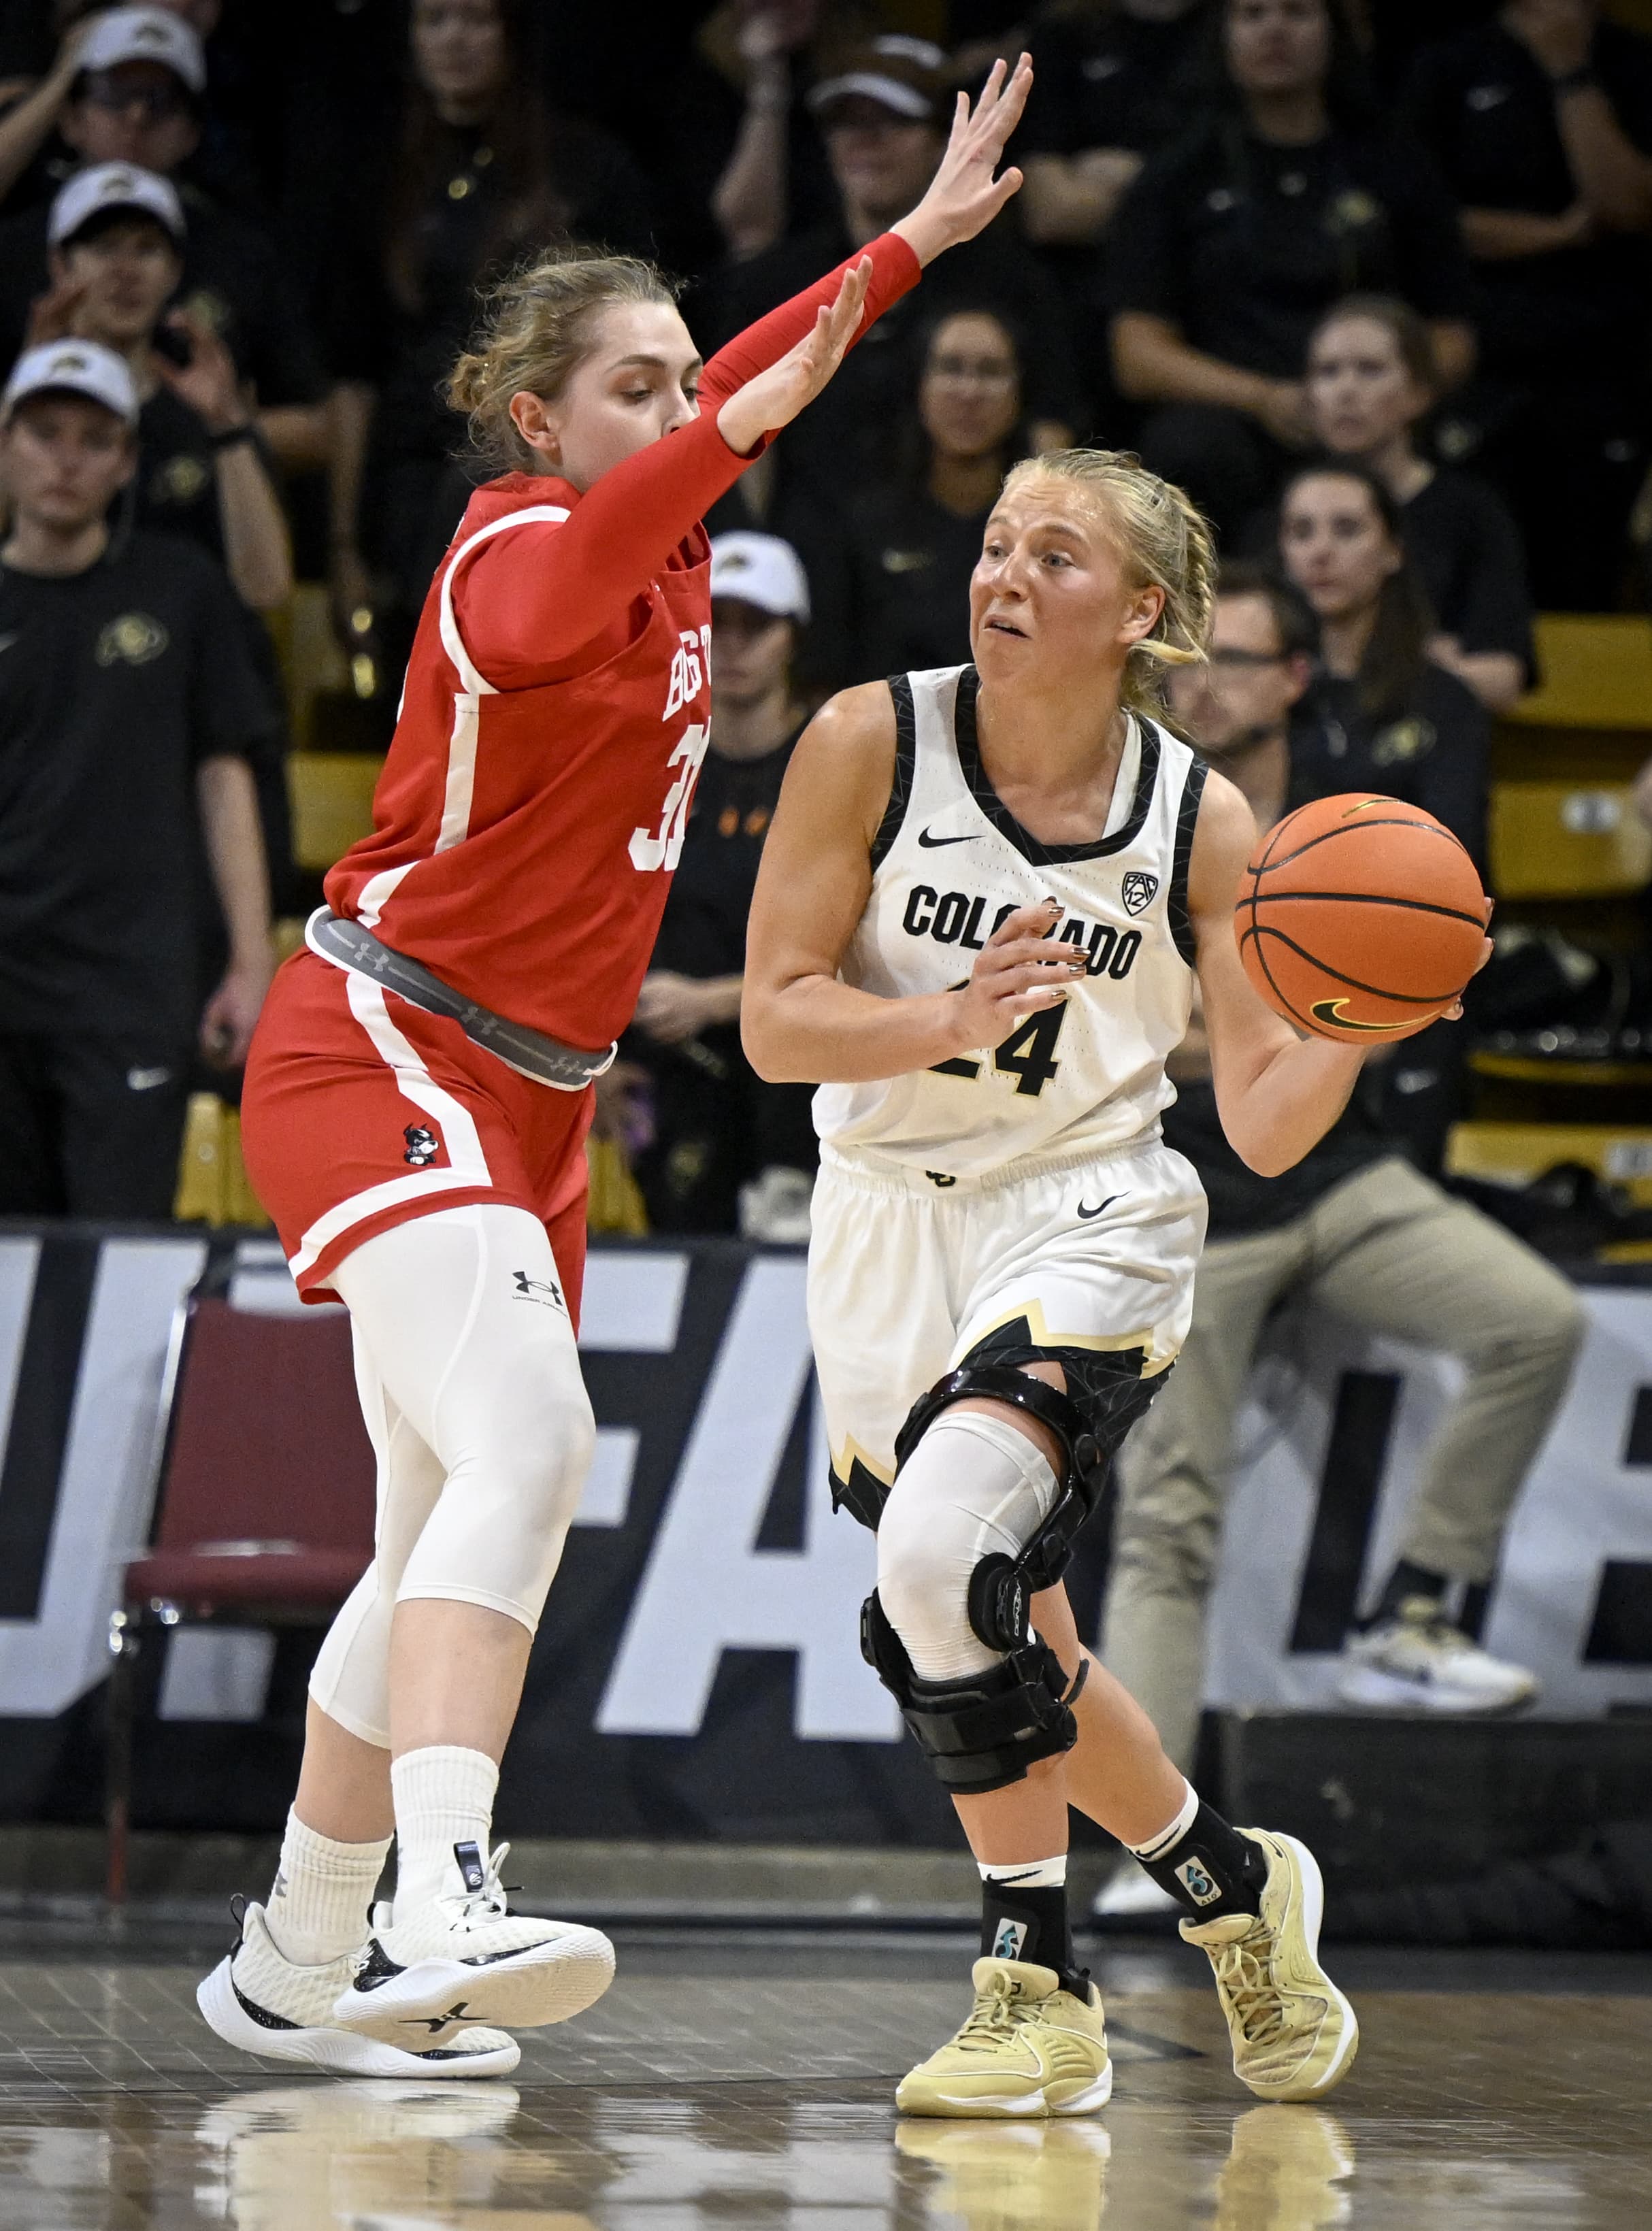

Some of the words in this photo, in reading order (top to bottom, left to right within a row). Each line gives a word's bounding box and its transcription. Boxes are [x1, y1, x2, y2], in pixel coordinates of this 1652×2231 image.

[1125, 875, 1155, 901] PAC
[1127, 891, 1146, 907] 12
[902, 885, 1142, 980] COLADO
[927, 980, 1070, 1097] 4
